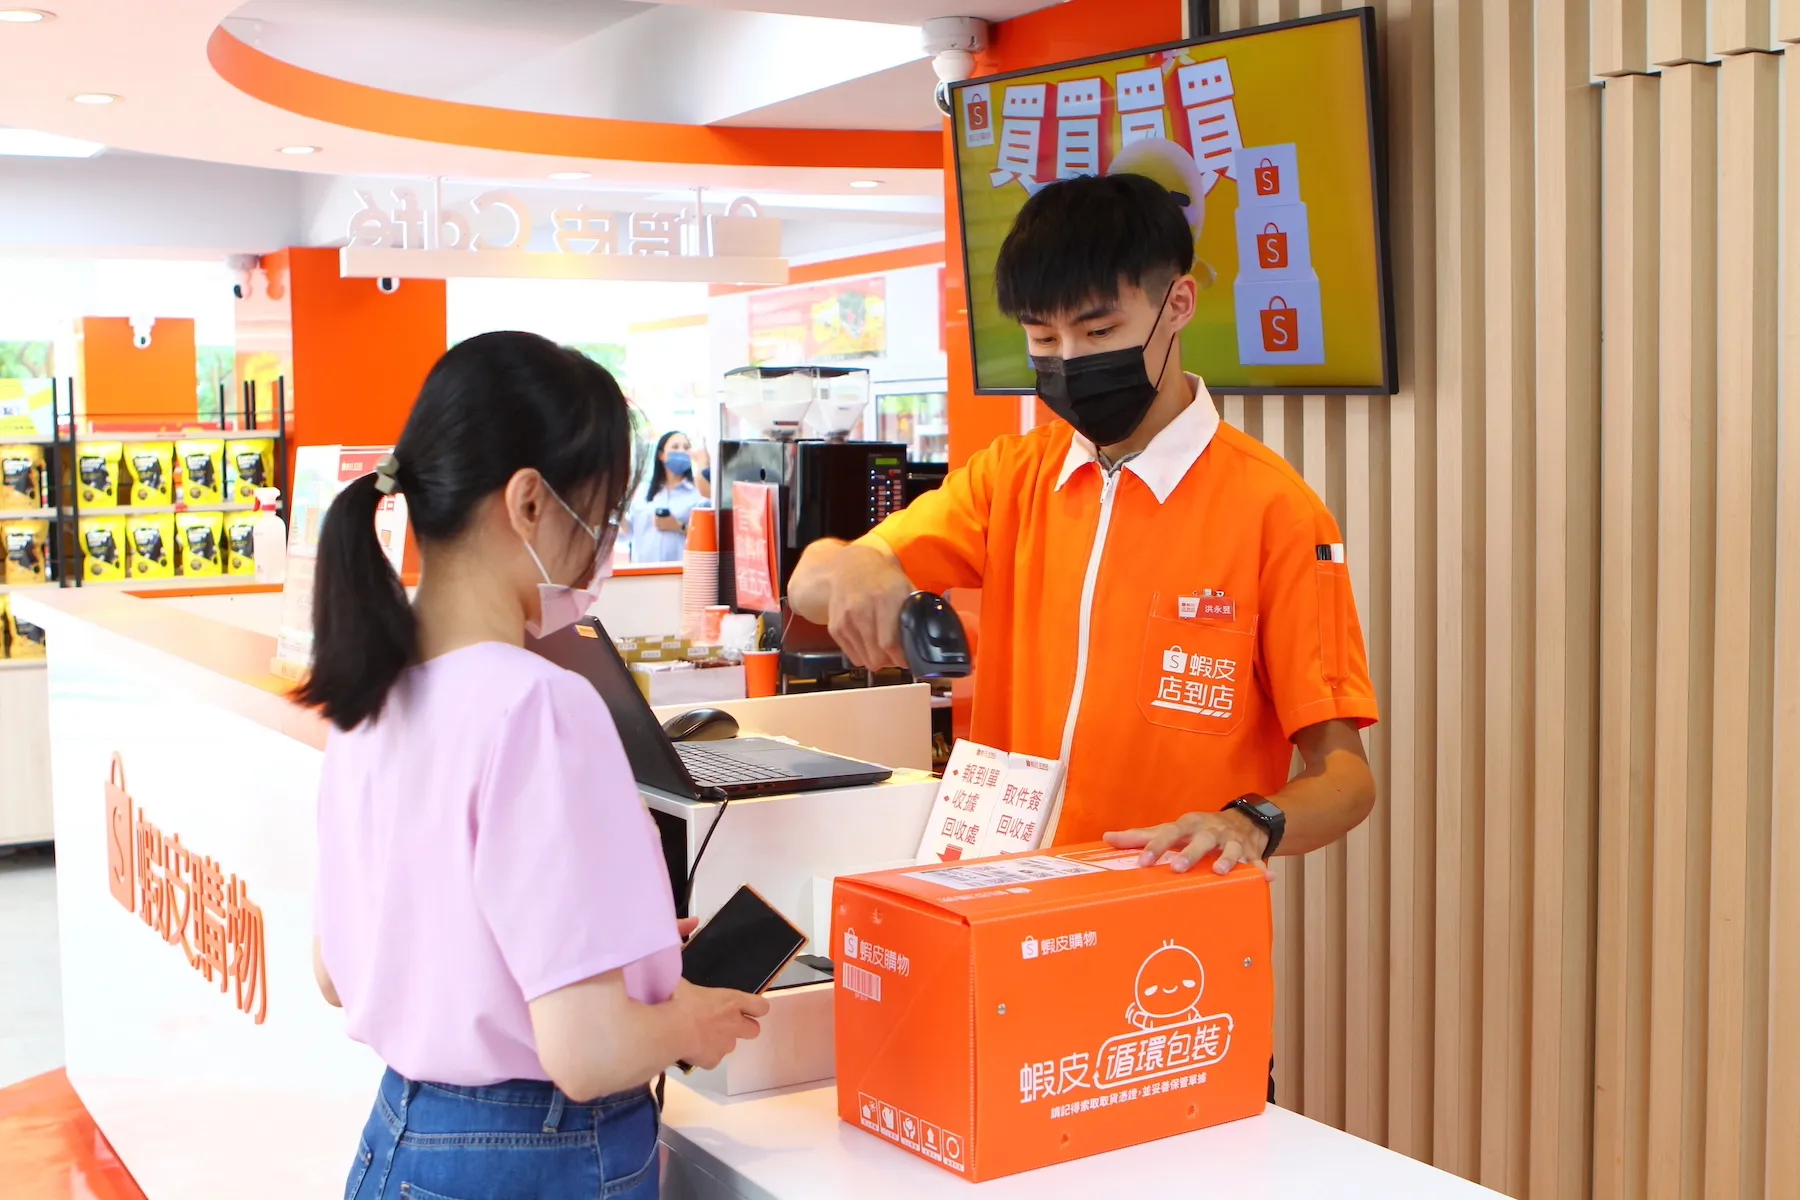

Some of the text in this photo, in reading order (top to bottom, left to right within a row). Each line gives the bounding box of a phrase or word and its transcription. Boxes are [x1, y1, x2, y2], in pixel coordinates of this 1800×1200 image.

[974, 106, 984, 126] S
[1262, 170, 1273, 191] S
[1266, 238, 1280, 263] S
[1271, 315, 1288, 345] S
[1169, 653, 1237, 683] S 蝦皮
[1157, 676, 1235, 710] 店到店
[961, 762, 1001, 789] 報到單
[951, 788, 980, 813] 收據
[941, 816, 981, 846] 回收處
[995, 814, 1037, 843] 回收處
[136, 807, 267, 1025] 蝦皮購物
[1041, 930, 1098, 956] 蝦皮購物
[860, 939, 911, 978] 蝦皮購物
[1019, 1023, 1221, 1104] 蝦皮 循環包裝
